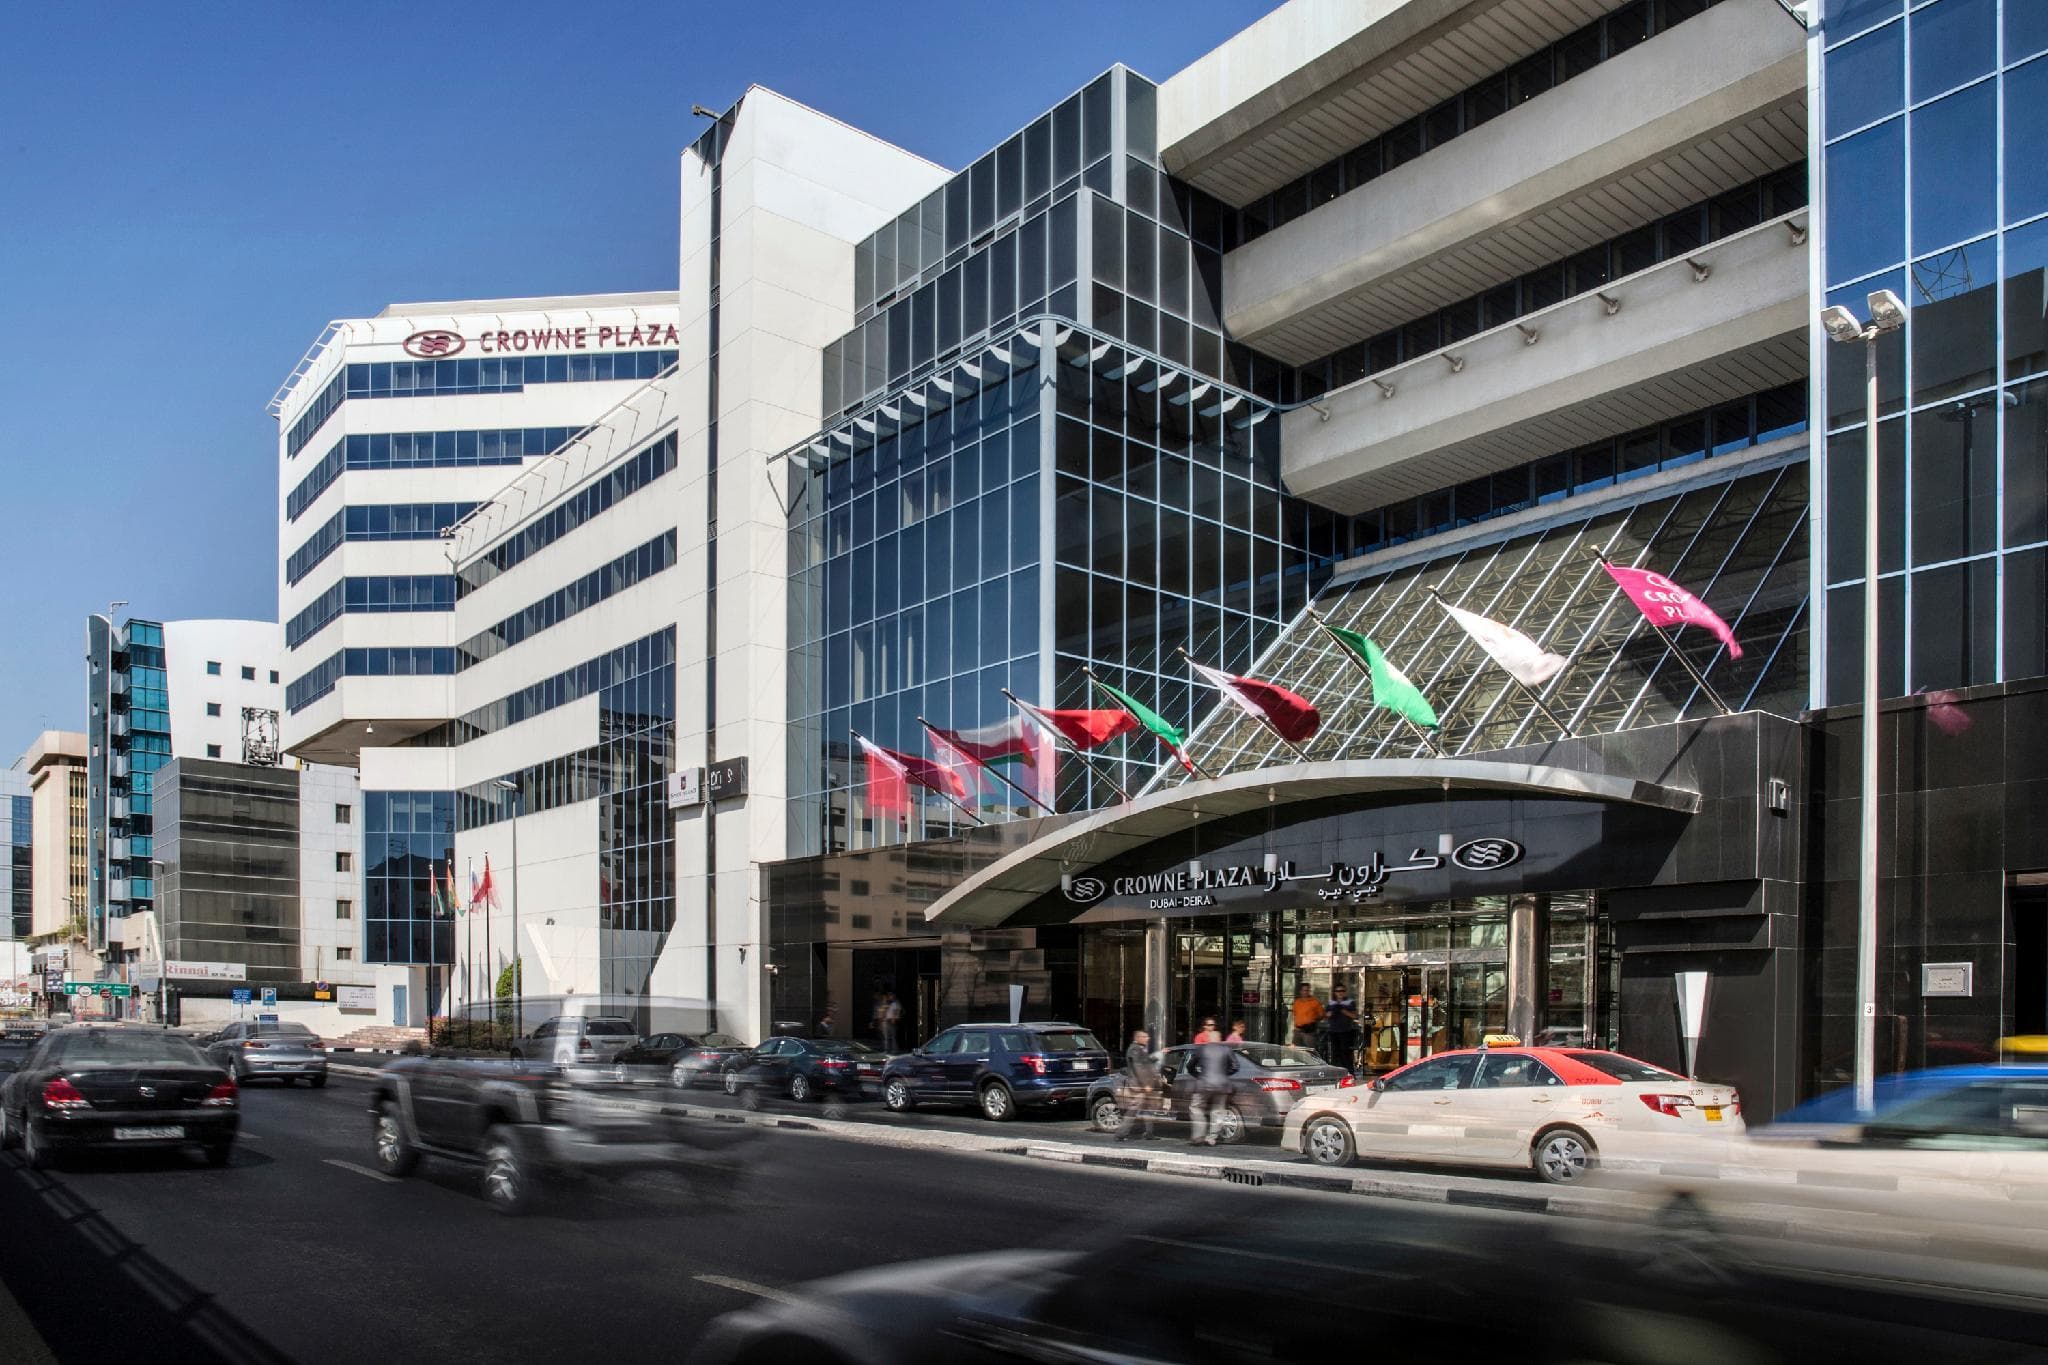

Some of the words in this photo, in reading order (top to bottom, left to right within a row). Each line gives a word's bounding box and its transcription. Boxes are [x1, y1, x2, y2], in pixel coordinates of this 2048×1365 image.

[480, 327, 586, 352] CROWNE
[599, 324, 679, 346] PLAZA
[1114, 872, 1186, 896] CROWNE
[1194, 866, 1252, 890] PLAZA
[1339, 848, 1439, 886] كراون
